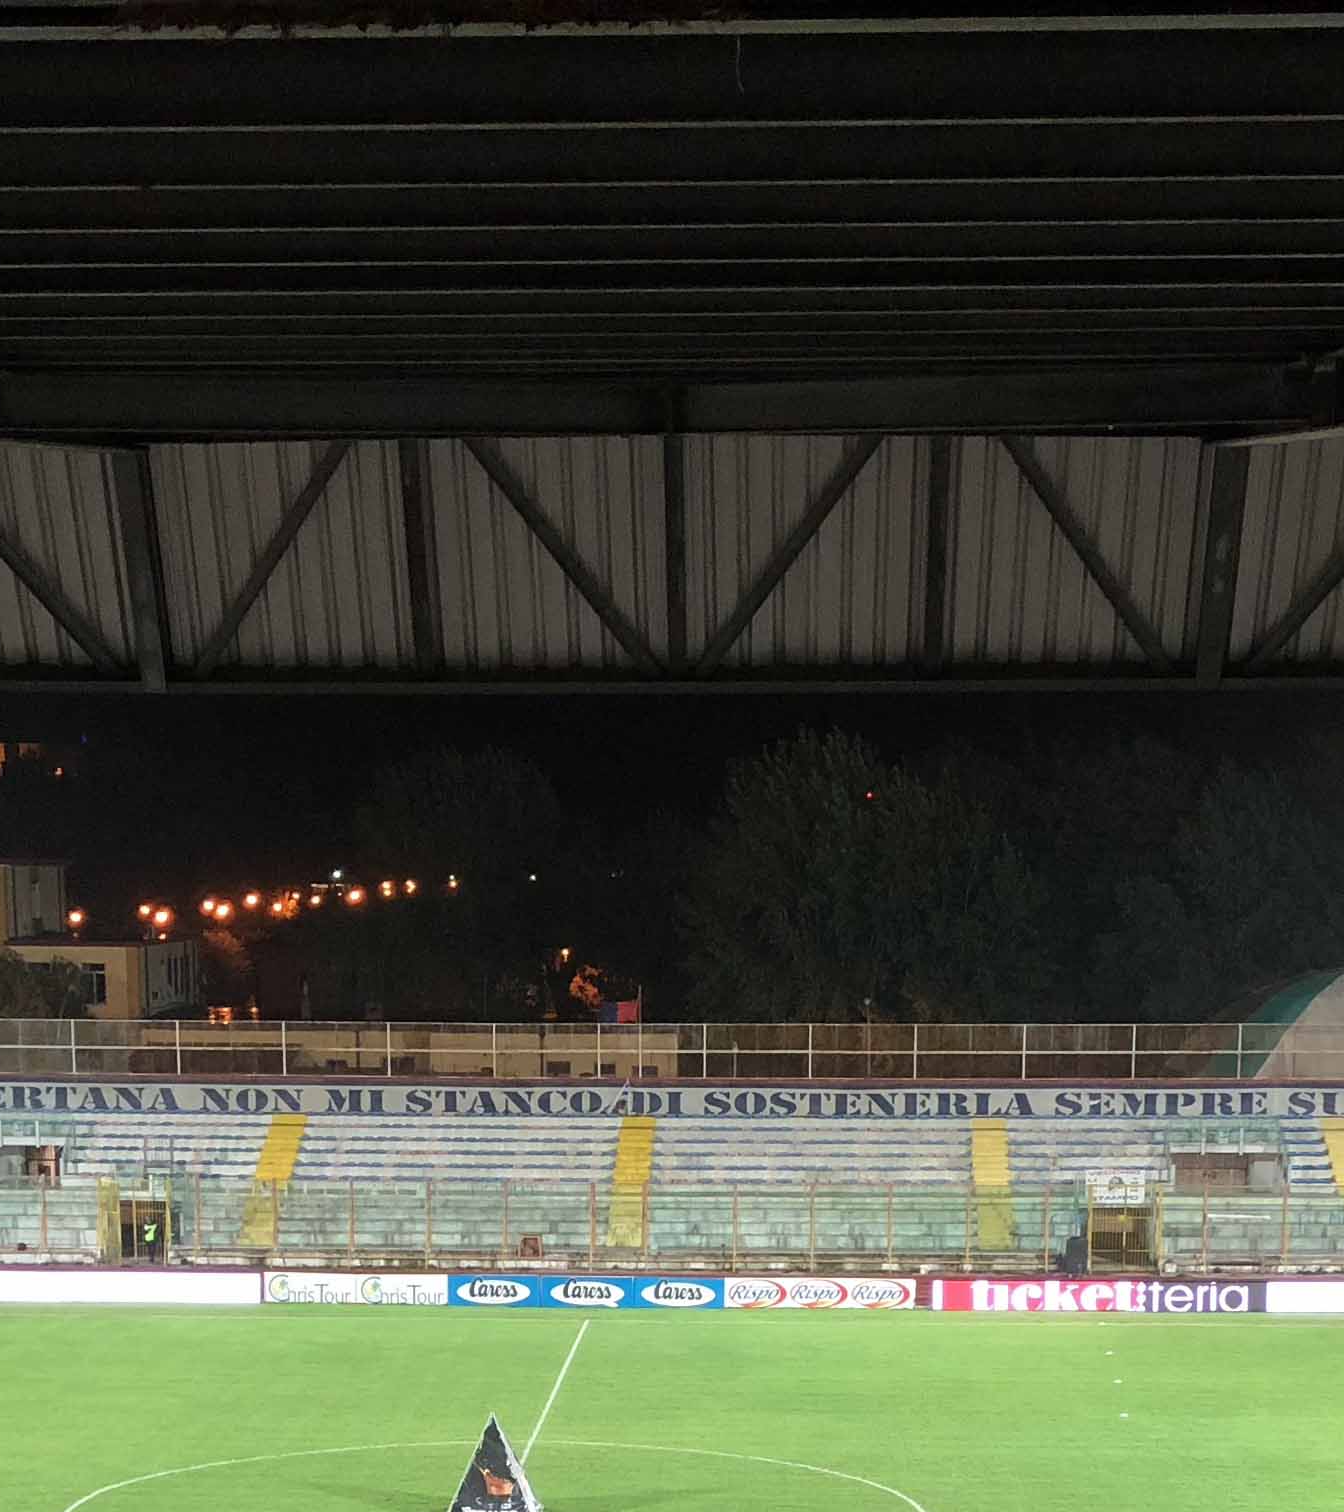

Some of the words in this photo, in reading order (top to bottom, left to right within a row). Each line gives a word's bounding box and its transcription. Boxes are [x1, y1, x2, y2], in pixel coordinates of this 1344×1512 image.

[200, 1086, 305, 1113] NON
[324, 1088, 386, 1113] MI
[405, 1088, 603, 1114] STANCO
[630, 1090, 683, 1115] DI
[704, 1090, 1035, 1117] SOSTENERLA
[1055, 1091, 1269, 1117] SEMPRE
[468, 1277, 519, 1299] Caress
[562, 1278, 613, 1300] Caress
[653, 1279, 704, 1301] Caress
